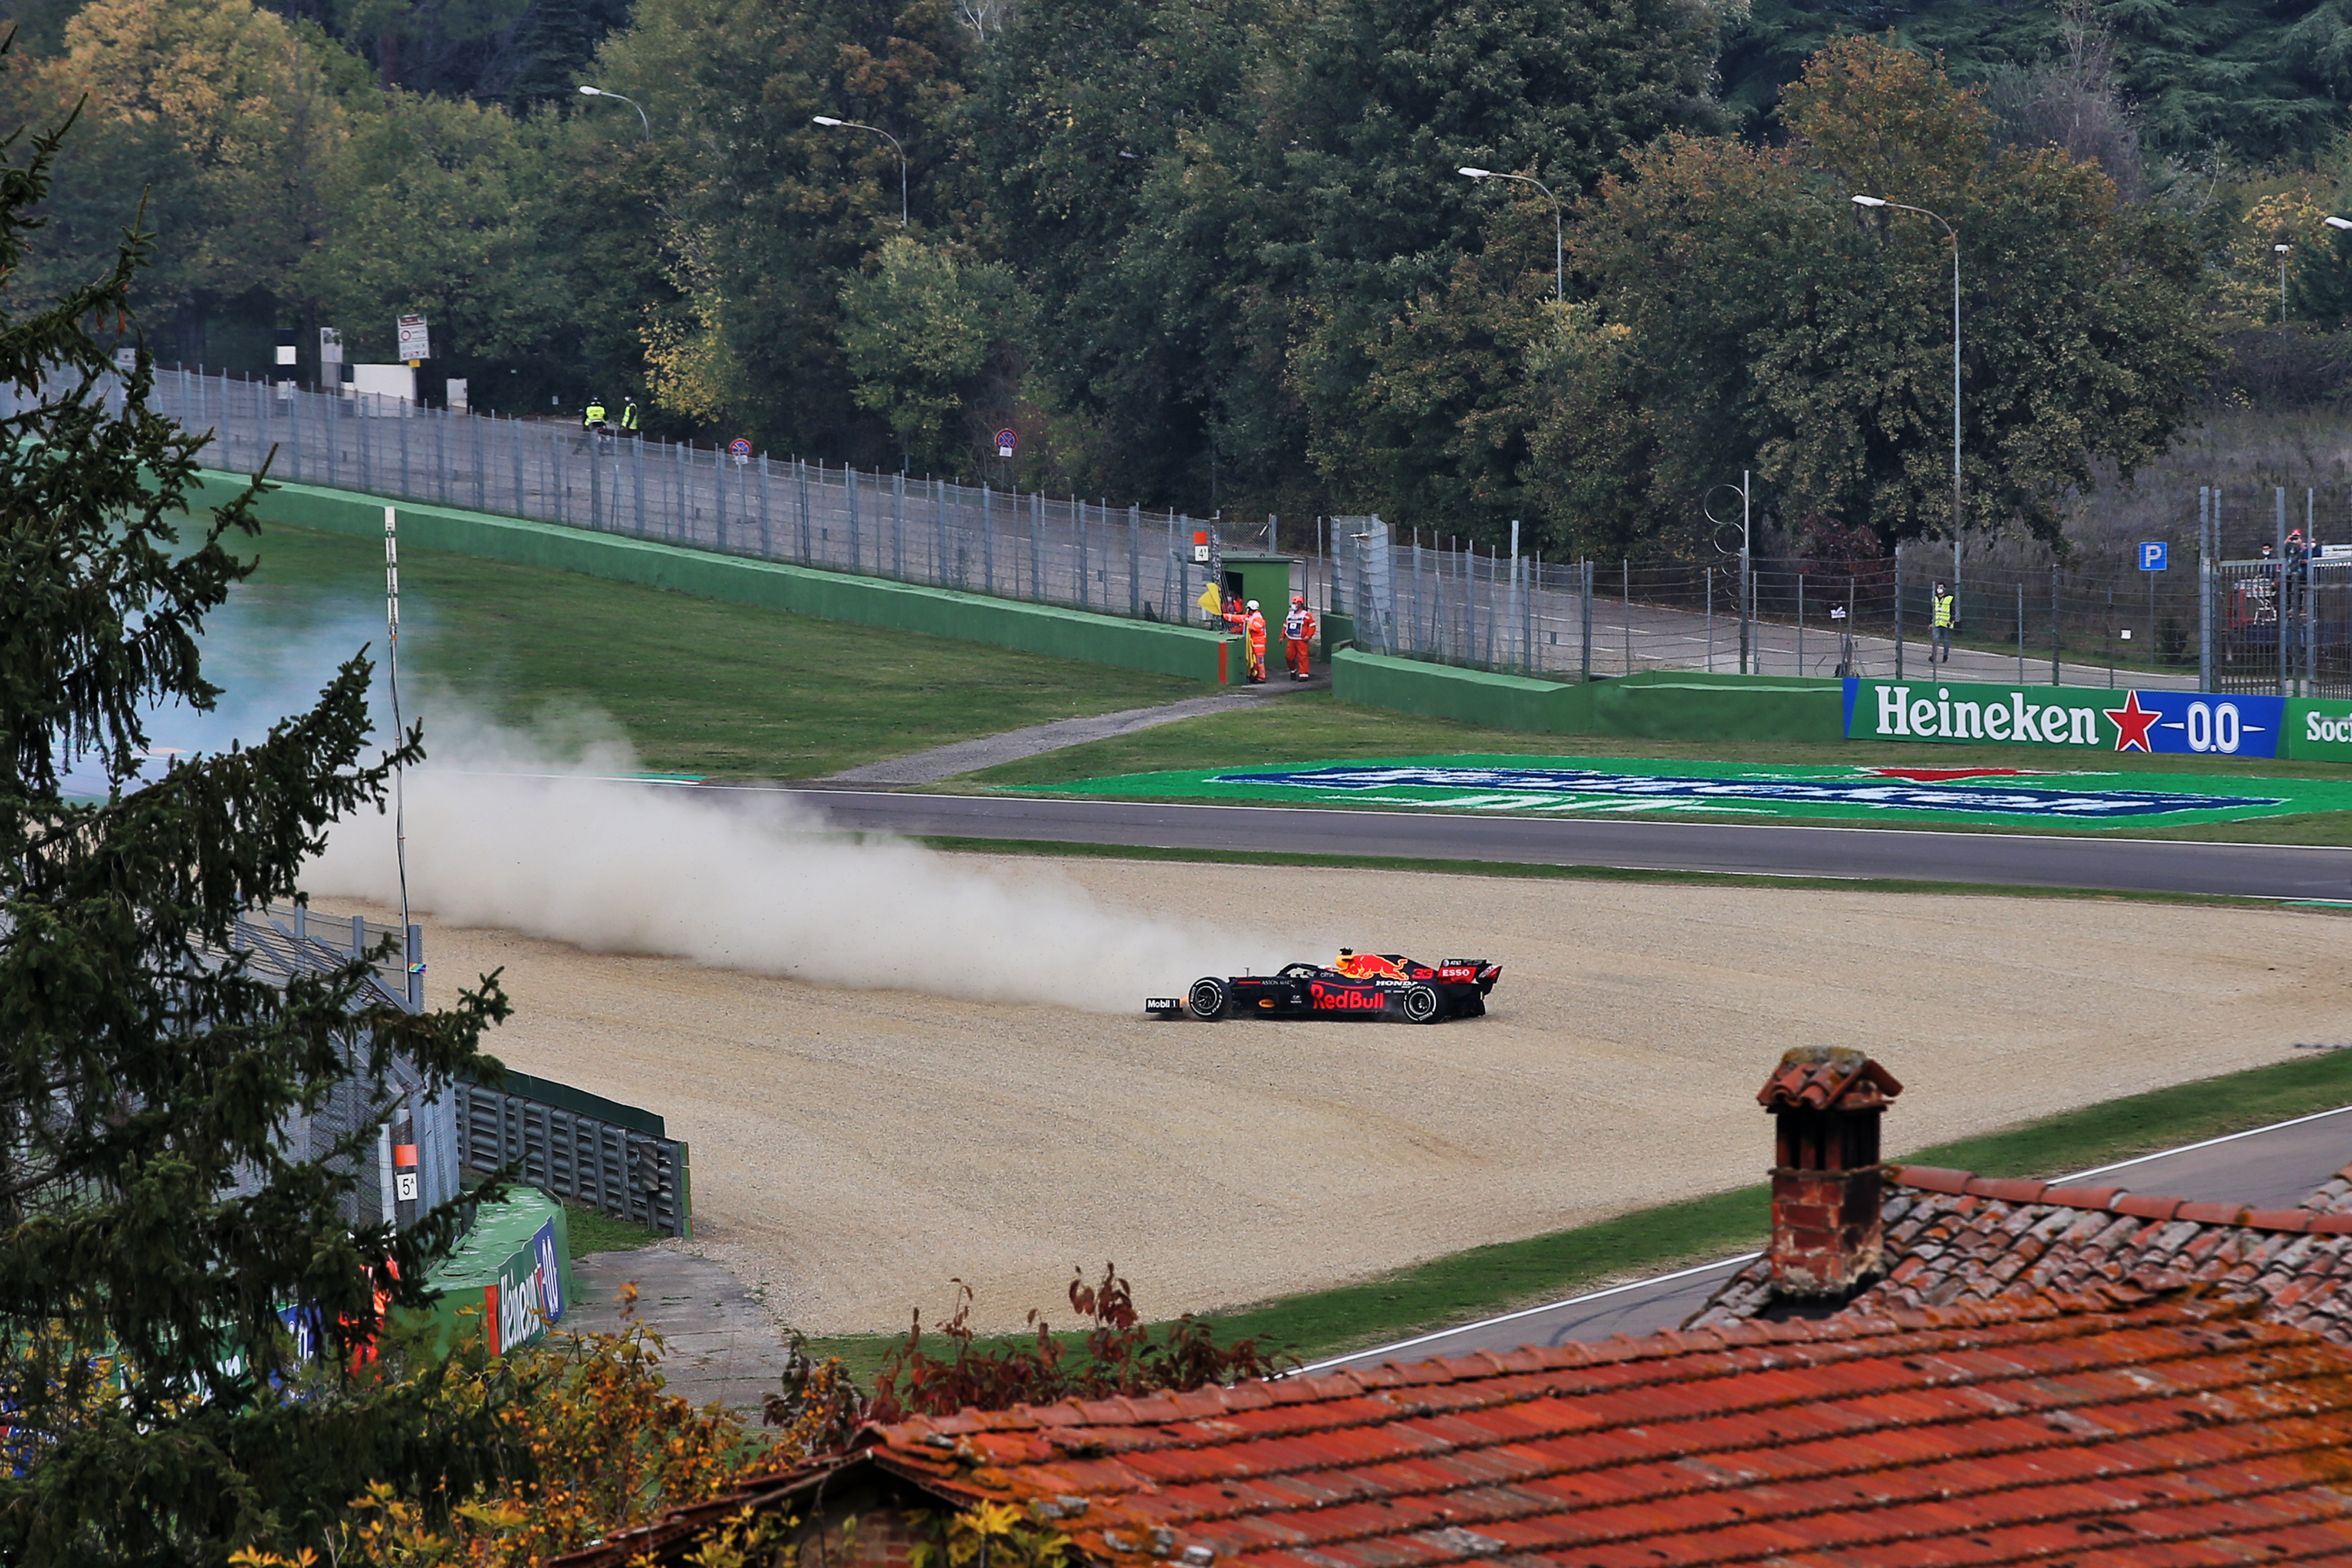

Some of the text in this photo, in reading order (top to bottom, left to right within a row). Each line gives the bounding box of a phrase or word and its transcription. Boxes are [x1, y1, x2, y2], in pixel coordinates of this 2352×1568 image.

[2146, 545, 2162, 567] P
[1875, 685, 2100, 745] Heineken
[2187, 701, 2239, 754] 0.0
[1411, 969, 1433, 979] 33
